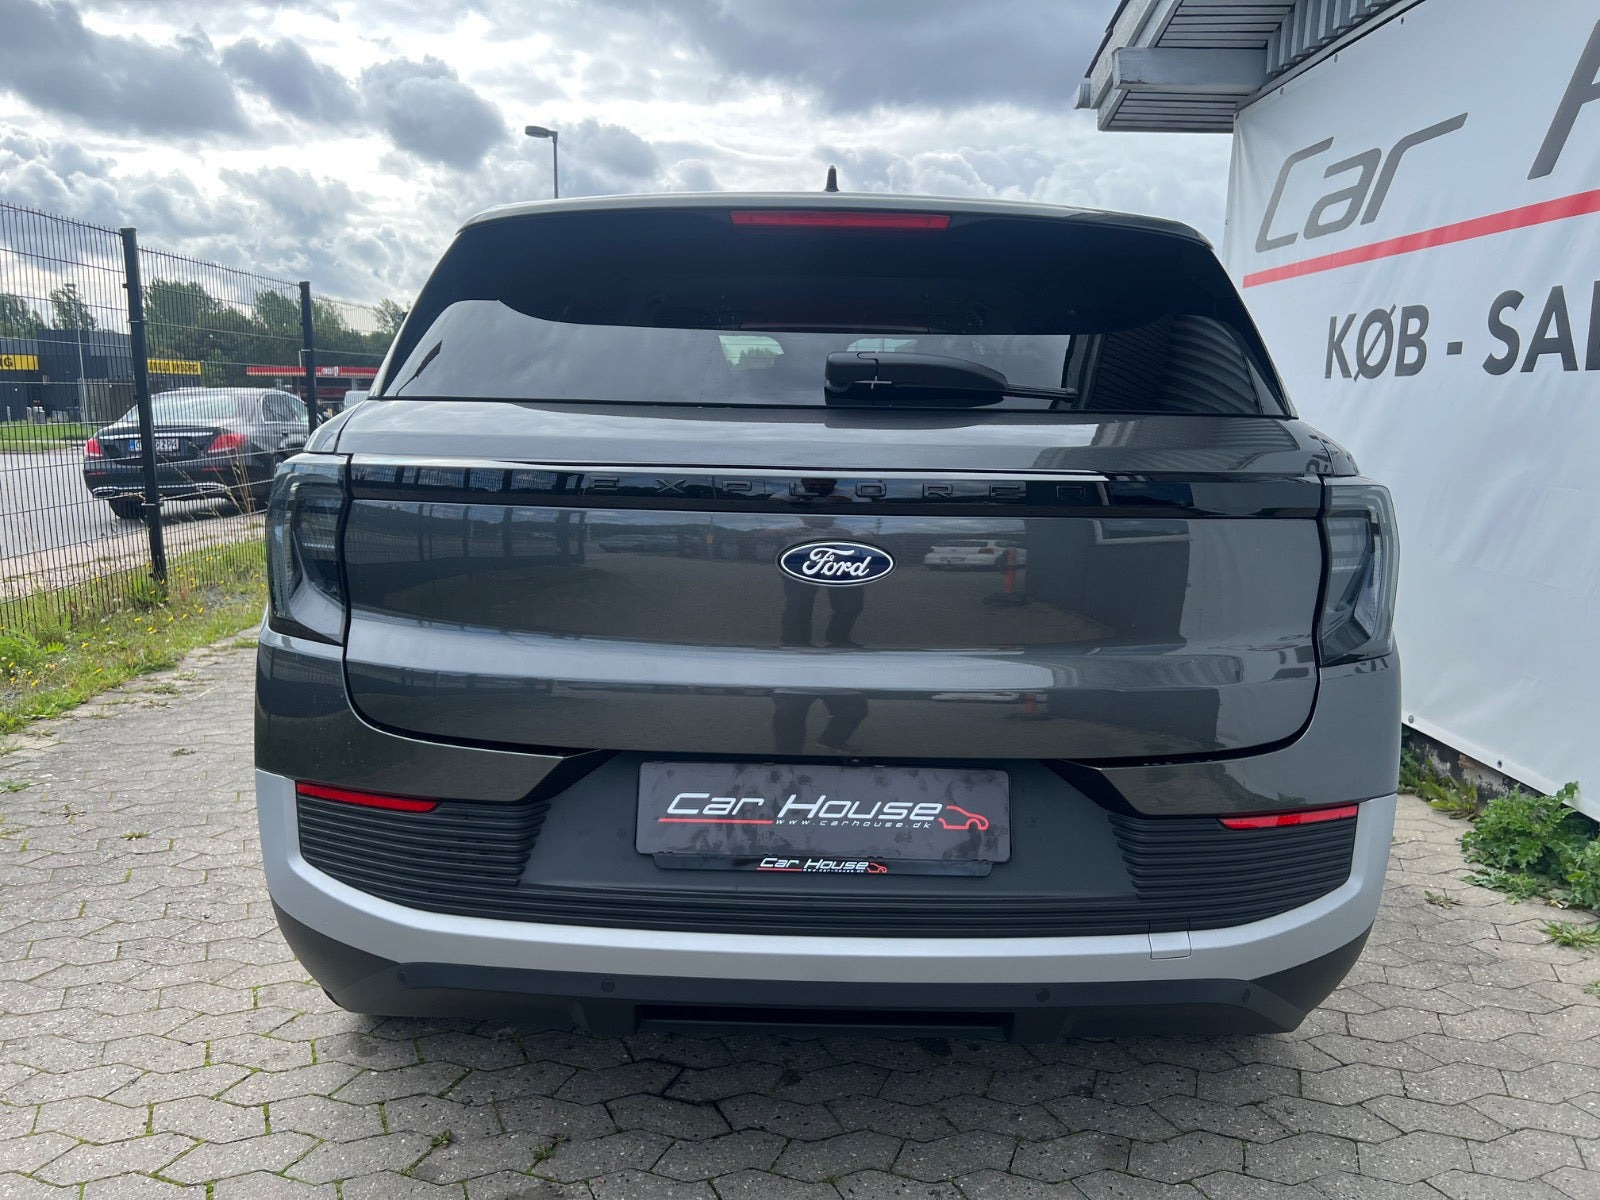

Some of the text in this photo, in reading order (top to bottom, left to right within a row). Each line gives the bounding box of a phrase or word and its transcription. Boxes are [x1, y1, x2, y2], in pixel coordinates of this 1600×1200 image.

[1255, 112, 1468, 253] Car
[1324, 303, 1430, 382] KØB
[590, 476, 1087, 500] EXPLORER
[802, 547, 872, 577] Ford
[667, 792, 943, 821] Car House
[775, 818, 931, 830] www.carhouse.dk
[760, 857, 869, 870] Car House
